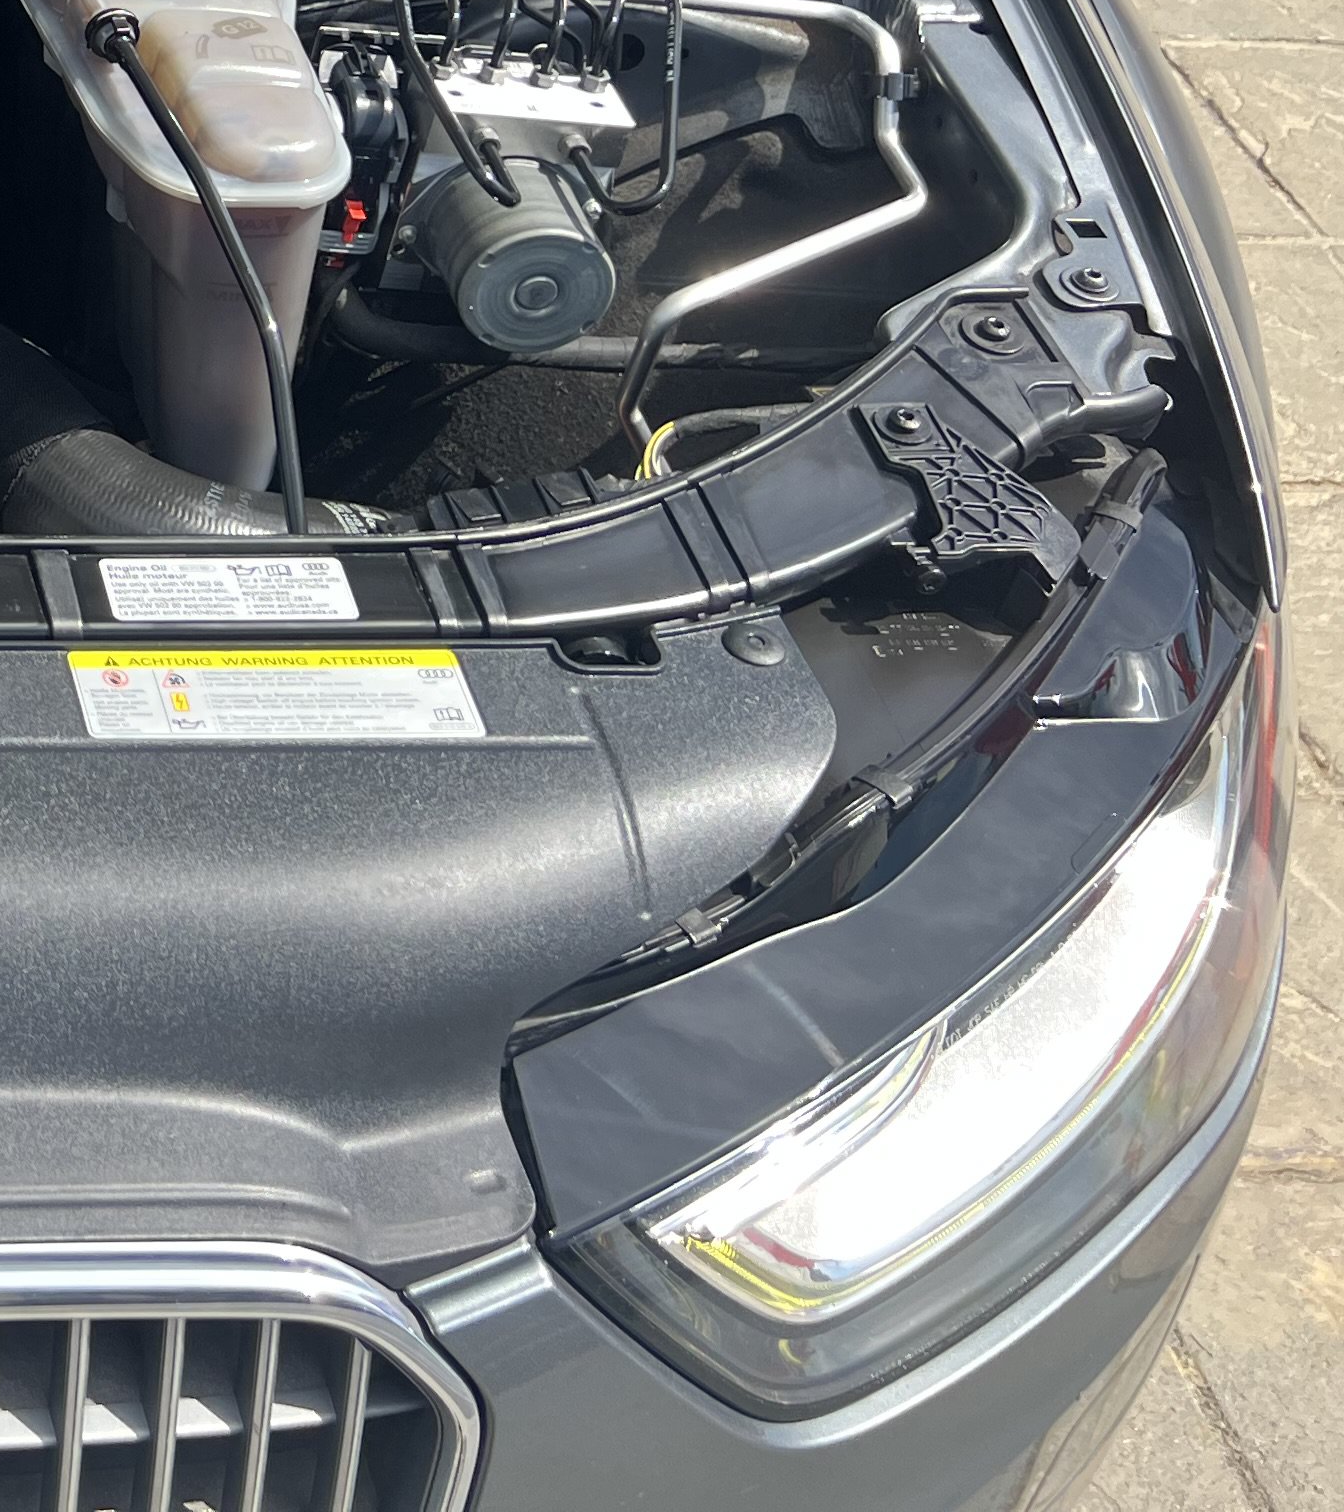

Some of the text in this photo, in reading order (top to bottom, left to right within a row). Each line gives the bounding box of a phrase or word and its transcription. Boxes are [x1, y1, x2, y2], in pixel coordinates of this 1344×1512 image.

[106, 564, 147, 573] Engine
[128, 655, 415, 666] ACHTUNG WARNING ATTENTION
